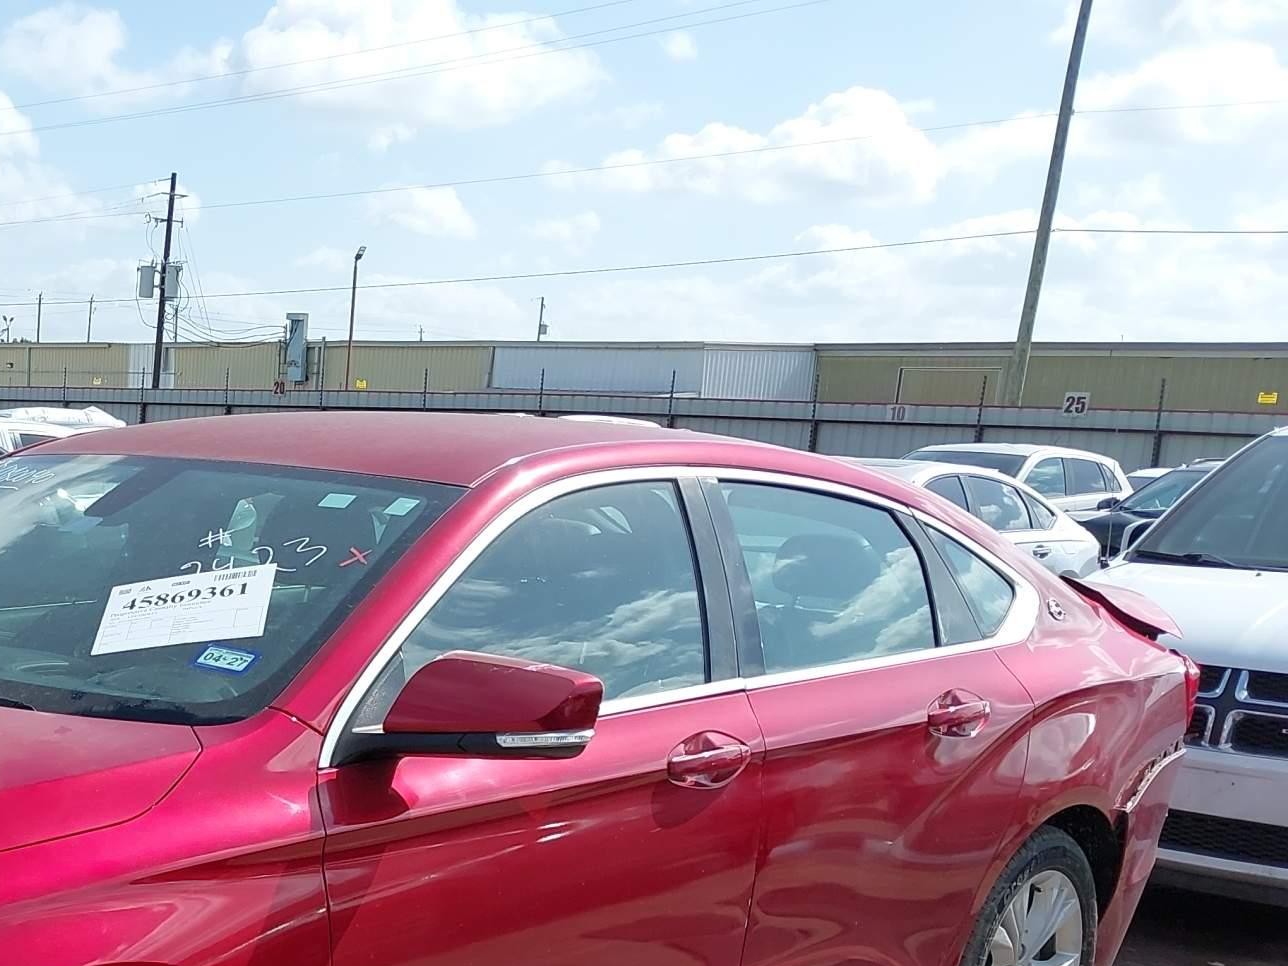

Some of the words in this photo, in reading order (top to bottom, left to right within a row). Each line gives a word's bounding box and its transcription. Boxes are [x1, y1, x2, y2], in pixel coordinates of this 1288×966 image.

[274, 381, 285, 394] 20
[1063, 395, 1087, 414] 25
[891, 406, 906, 421] 10
[122, 582, 248, 611] 45869361
